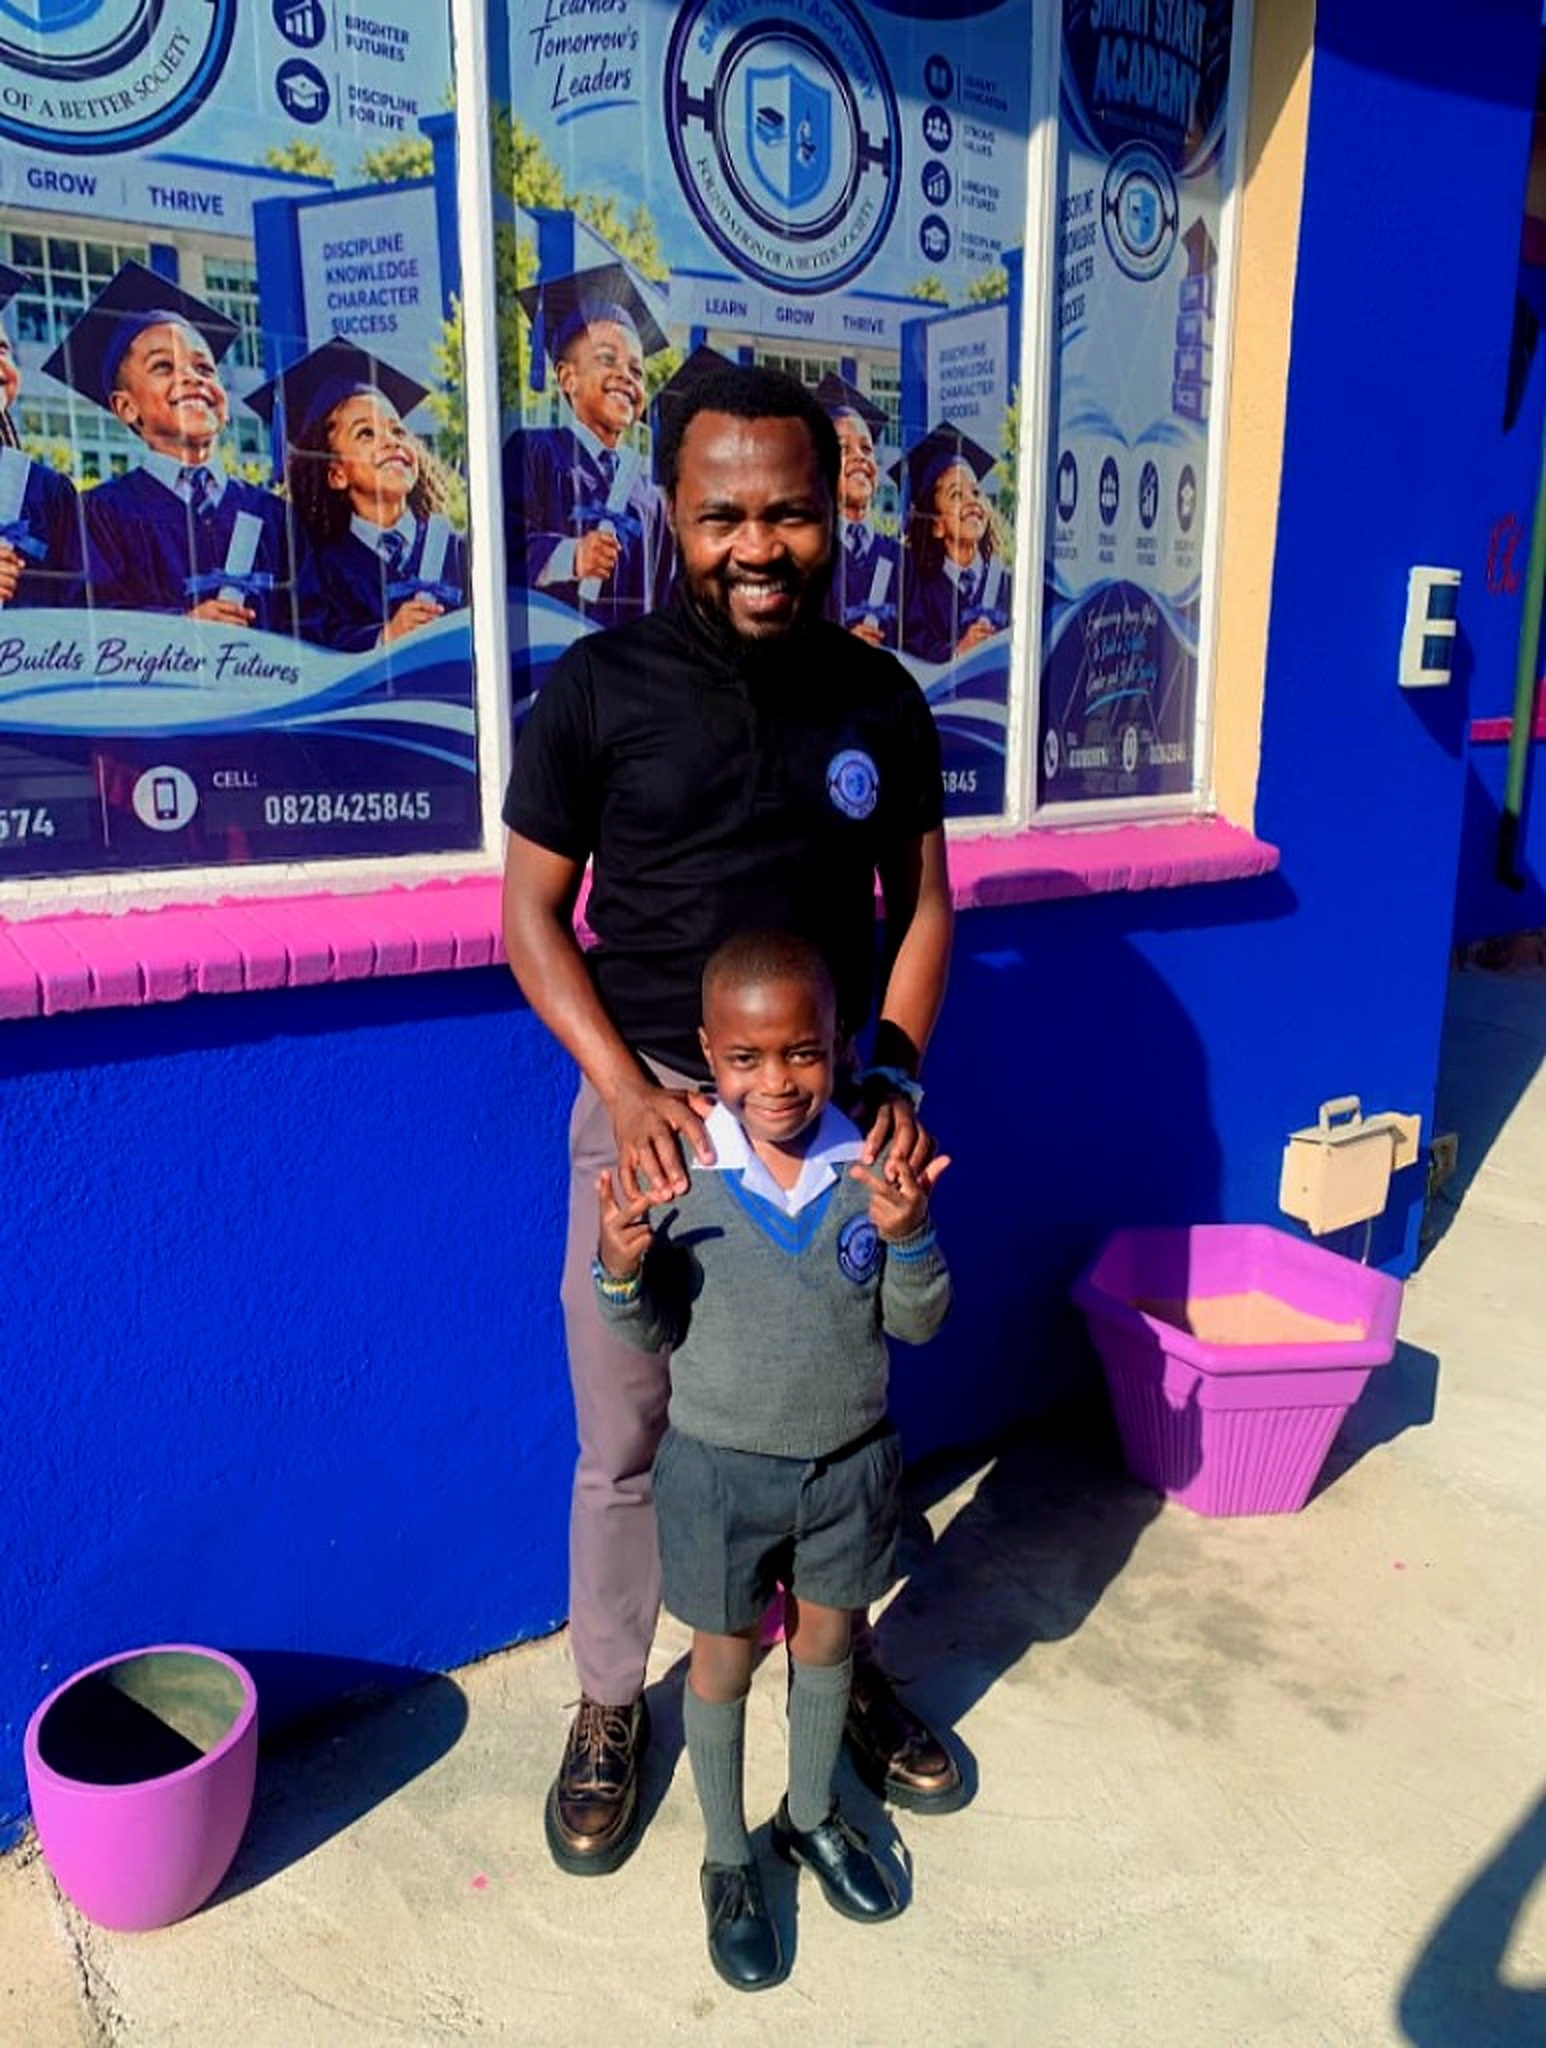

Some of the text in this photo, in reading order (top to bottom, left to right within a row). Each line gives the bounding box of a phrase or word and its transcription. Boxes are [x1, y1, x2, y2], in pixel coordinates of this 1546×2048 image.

[345, 14, 409, 45] BRIGHTER
[529, 23, 638, 66] Tomorrow's
[346, 33, 405, 62] FUTURES
[3, 26, 191, 119] OF A BETTER SOCIETY
[551, 58, 632, 111] Leaders
[1093, 34, 1201, 132] ACADEMY
[348, 84, 418, 116] DISCIPLINE
[349, 104, 404, 131] FOR LIFE
[27, 168, 225, 216] GROW THRIVE
[323, 232, 403, 261] DISCIPLINE
[326, 258, 419, 285] KNOWLEDGE
[327, 286, 419, 310] CHARACTER
[331, 313, 398, 336] SUCCESS
[705, 298, 885, 335] LEARN GROW THRIVE
[0, 638, 299, 685] Builds Brighter Futures
[212, 770, 258, 788] CELL:
[264, 792, 431, 825] 0828425845
